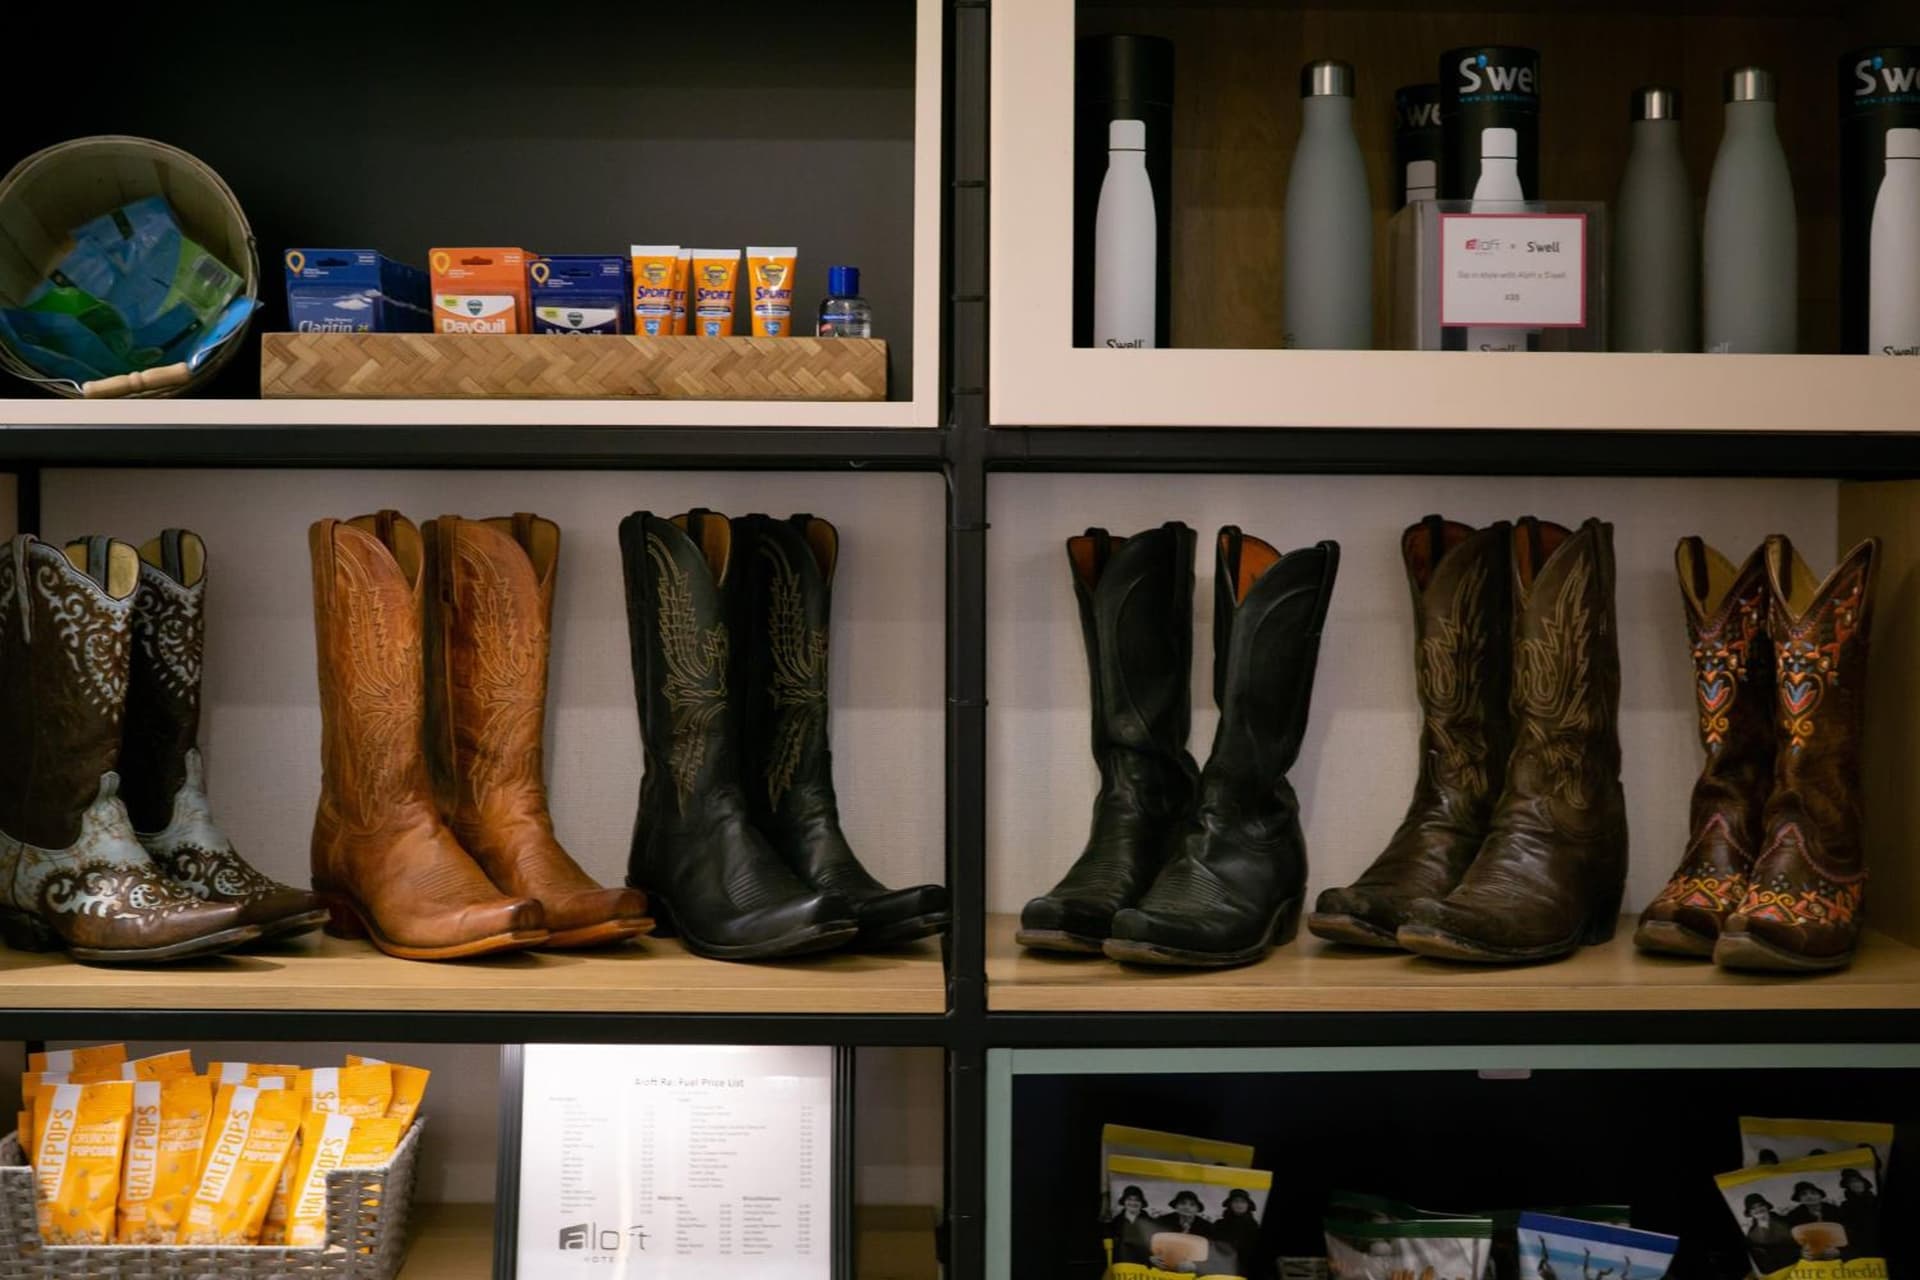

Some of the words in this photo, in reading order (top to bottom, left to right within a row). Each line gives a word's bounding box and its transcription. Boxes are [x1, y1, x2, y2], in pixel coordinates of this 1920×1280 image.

[637, 285, 672, 299] SPORT
[697, 288, 732, 301] SPORT
[755, 287, 791, 300] SPORT
[443, 318, 506, 333] DayQuil
[727, 1078, 745, 1088] List
[127, 1105, 158, 1197] HALFPOPS
[200, 1109, 250, 1199] HALFPOPS
